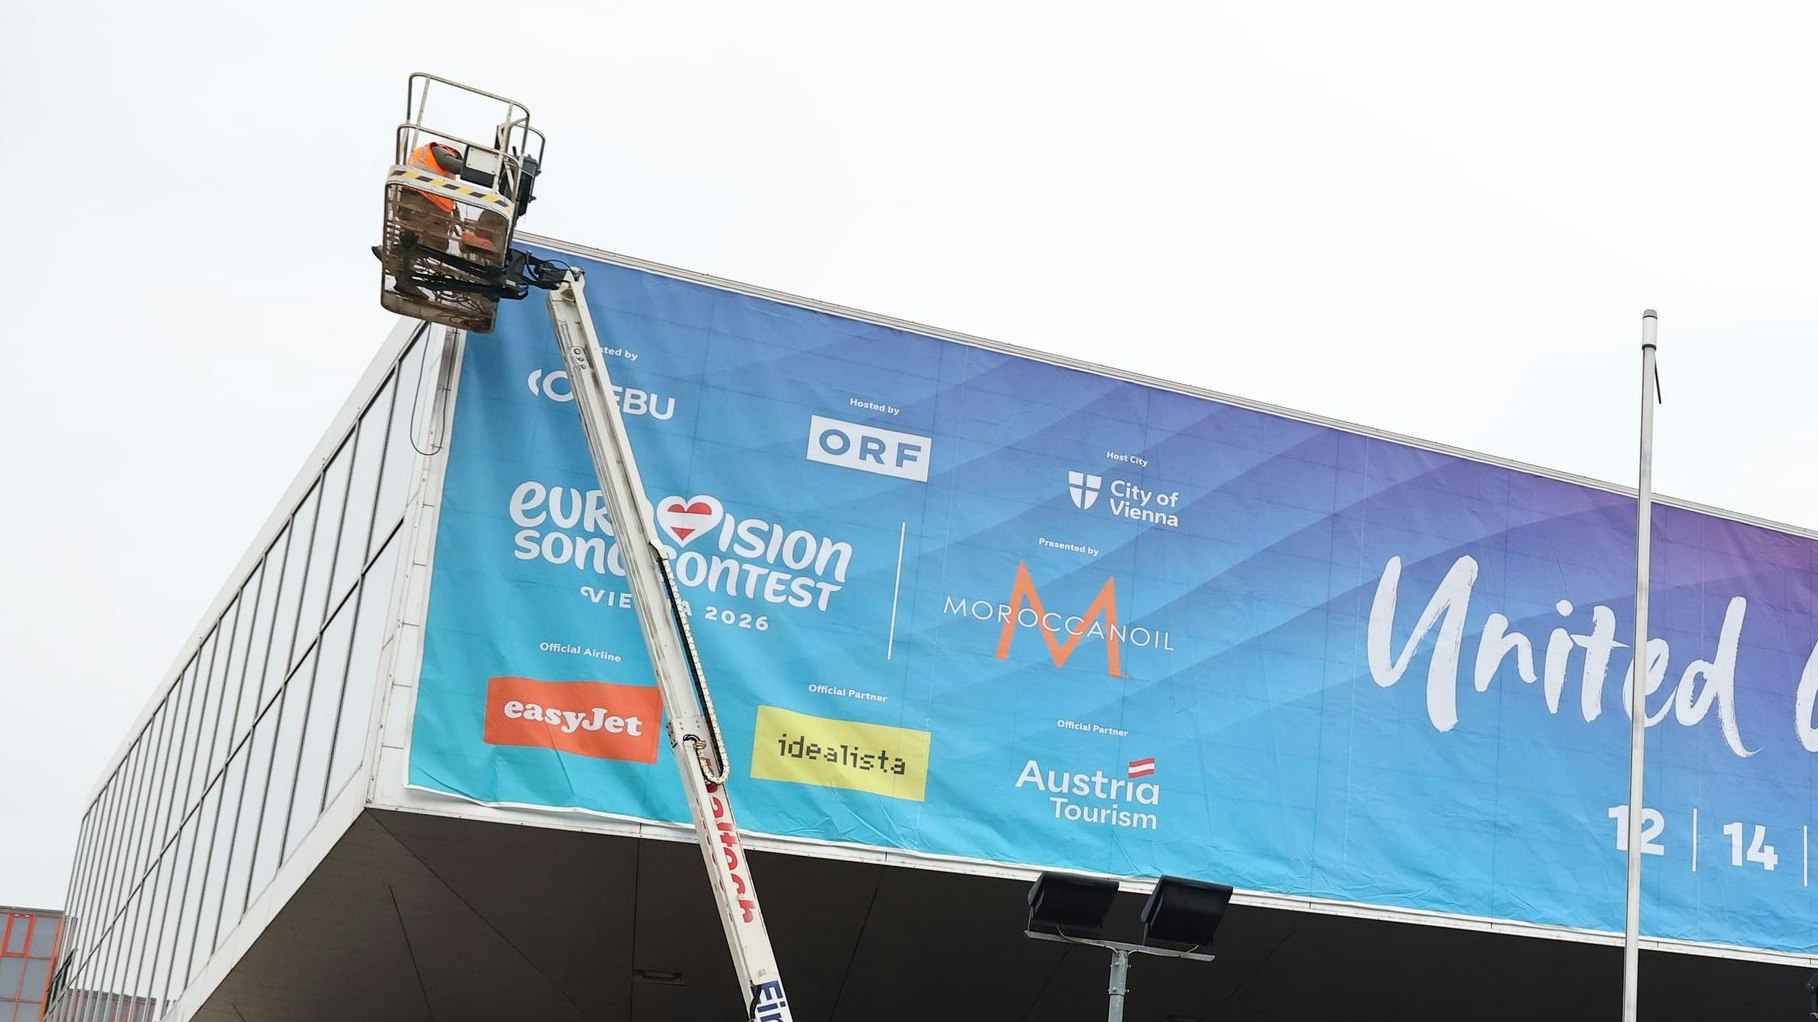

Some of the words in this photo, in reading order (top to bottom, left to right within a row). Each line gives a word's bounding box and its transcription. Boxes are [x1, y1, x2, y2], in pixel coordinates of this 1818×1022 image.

[624, 350, 639, 361] by
[850, 398, 885, 412] Hosted
[887, 404, 900, 416] by
[819, 429, 922, 467] ORF
[1106, 451, 1128, 463] Host
[1129, 455, 1148, 467] City
[1110, 480, 1152, 501] City
[1157, 492, 1179, 507] of
[1110, 499, 1179, 527] Vienna
[1039, 537, 1085, 553] Presented
[1087, 547, 1099, 557] by
[667, 543, 842, 612] ONTEST
[704, 606, 769, 631] 2026
[944, 596, 1174, 651] MOROCCANOIL
[540, 642, 580, 657] Official
[583, 648, 622, 663] Airline
[1367, 555, 1762, 757] United
[808, 684, 846, 698] Official
[847, 689, 888, 703] Partner
[503, 700, 643, 738] easyJet
[1057, 719, 1091, 733] Official
[1093, 724, 1129, 737] Partner
[778, 734, 906, 776] idealista
[1015, 760, 1160, 805] Austria
[1050, 796, 1157, 830] Tourism
[1608, 804, 1666, 857] 12
[1724, 821, 1779, 871] 14
